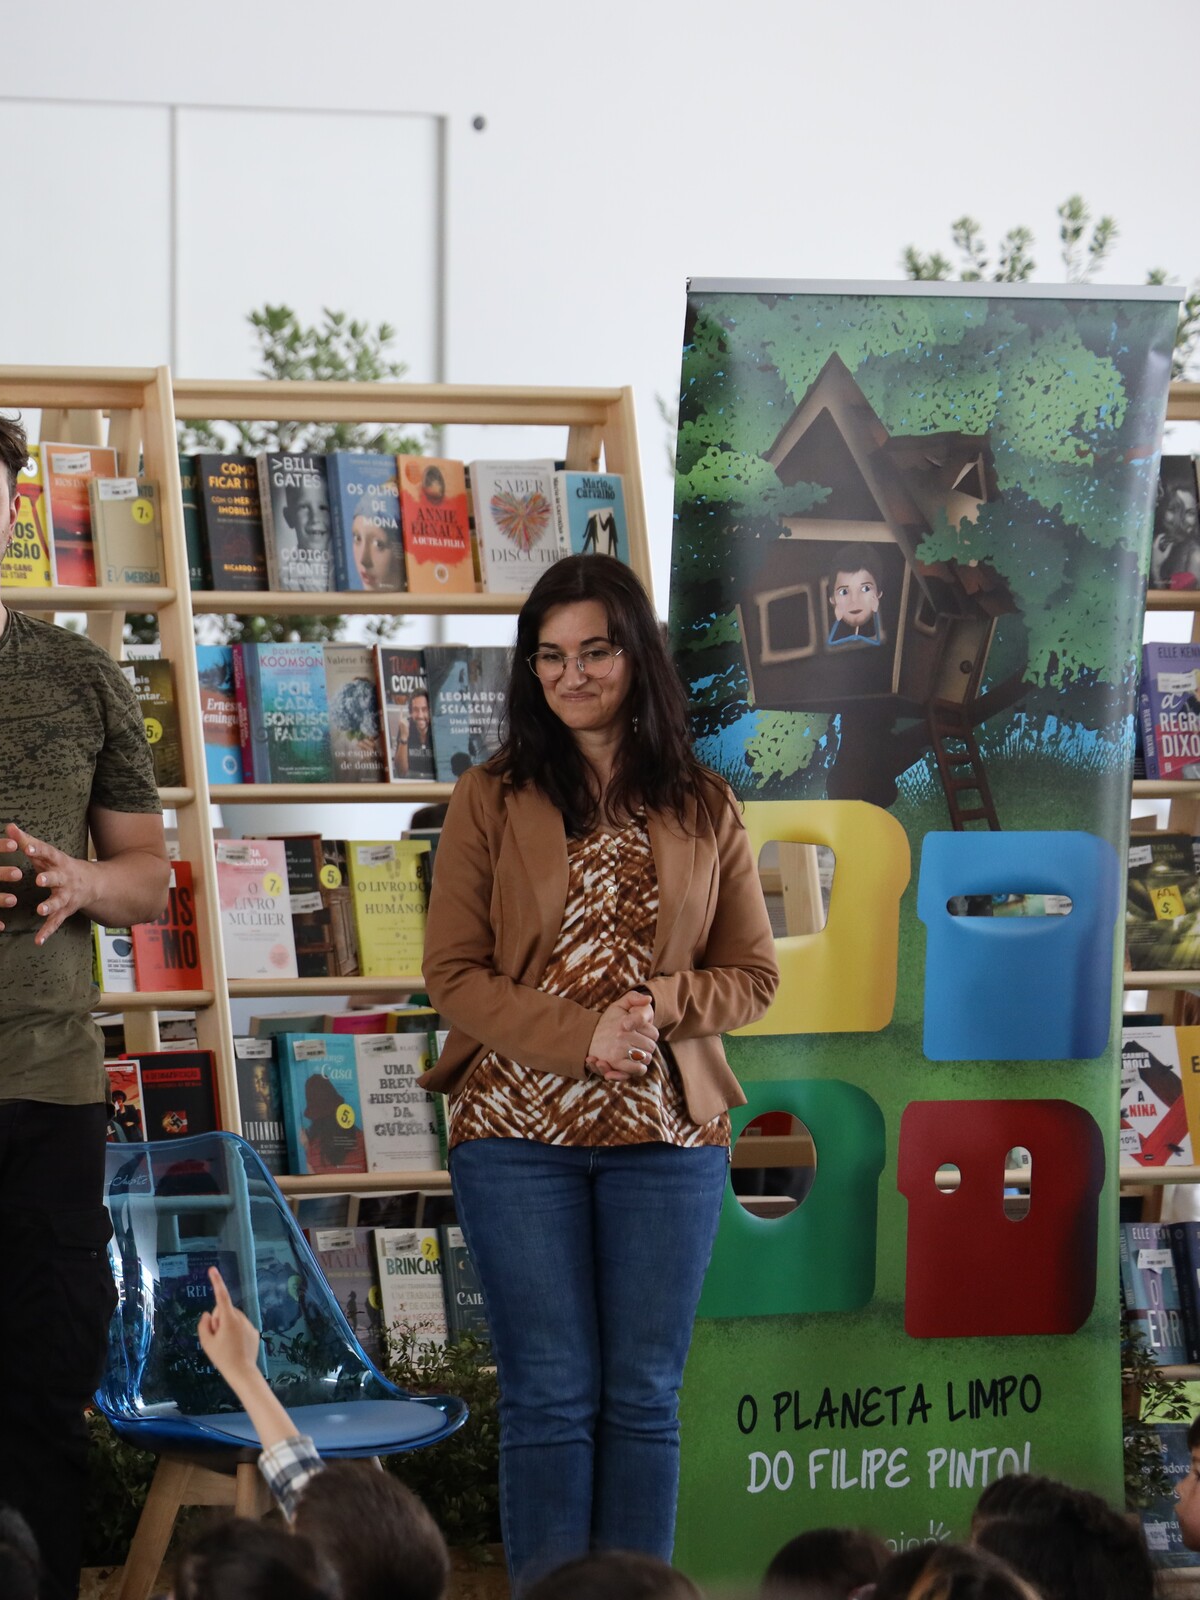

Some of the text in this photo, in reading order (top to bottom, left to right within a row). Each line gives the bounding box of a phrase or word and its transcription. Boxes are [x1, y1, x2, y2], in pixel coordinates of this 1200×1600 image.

[209, 476, 242, 489] FICAR
[274, 472, 321, 488] GATES
[493, 478, 544, 493] SABER
[347, 483, 364, 495] OS
[575, 486, 616, 501] Carvalho
[372, 500, 387, 513] DE
[363, 516, 399, 529] MONA
[416, 508, 458, 524] ANNIE
[410, 520, 465, 540] ERNAUX
[412, 536, 466, 549] A OUTRA FILHA
[124, 569, 161, 584] IMERSÃO
[1158, 647, 1178, 659] ELLE
[260, 655, 324, 668] KOOMSON
[327, 655, 358, 665] Valérie
[277, 681, 311, 695] POR
[439, 692, 506, 702] LEONARDO
[274, 697, 316, 711] CADA
[441, 703, 493, 715] SCIASCIA
[264, 711, 329, 727] SORRISO
[450, 717, 468, 725] UMA
[274, 727, 324, 742] FALSO
[451, 726, 483, 735] SIMPLES
[340, 761, 353, 770] de
[246, 882, 256, 894] O
[358, 881, 406, 892] O LIVRO
[232, 897, 273, 911] LIVRO
[227, 914, 284, 927] MULHER
[161, 929, 198, 969] MO
[384, 1064, 415, 1075] UMA
[1122, 1058, 1151, 1069] MOLA
[321, 1063, 353, 1080] Casa
[1138, 1090, 1145, 1103] A
[393, 1106, 414, 1118] DA
[1128, 1103, 1158, 1117] NINA
[1132, 1226, 1150, 1240] ELLE
[386, 1258, 442, 1275] BRINCAR
[737, 1373, 1042, 1434] O PLANETA LIMPO
[747, 1450, 795, 1493] DO
[808, 1447, 911, 1490] FILIPE
